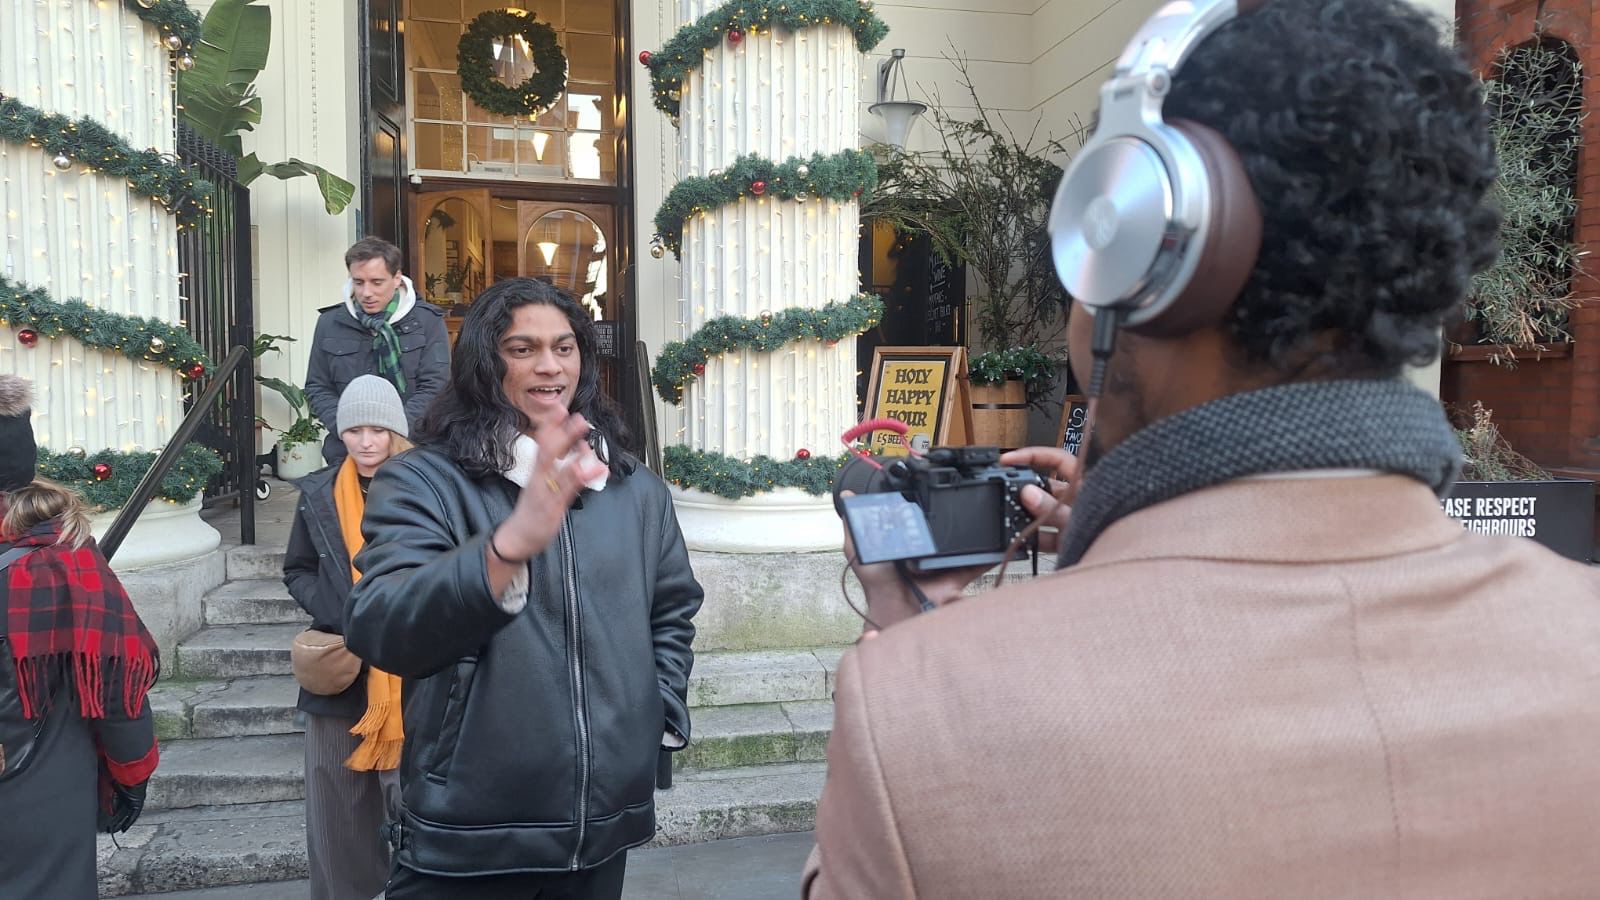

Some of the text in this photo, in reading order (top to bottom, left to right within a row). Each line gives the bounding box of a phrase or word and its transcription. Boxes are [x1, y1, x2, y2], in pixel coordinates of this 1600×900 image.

[895, 369, 933, 384] HOLY
[885, 389, 936, 406] HAPPY
[886, 410, 928, 427] HOUR
[1476, 497, 1537, 517] RESPECT
[1461, 519, 1536, 537] EIGHBOURS
